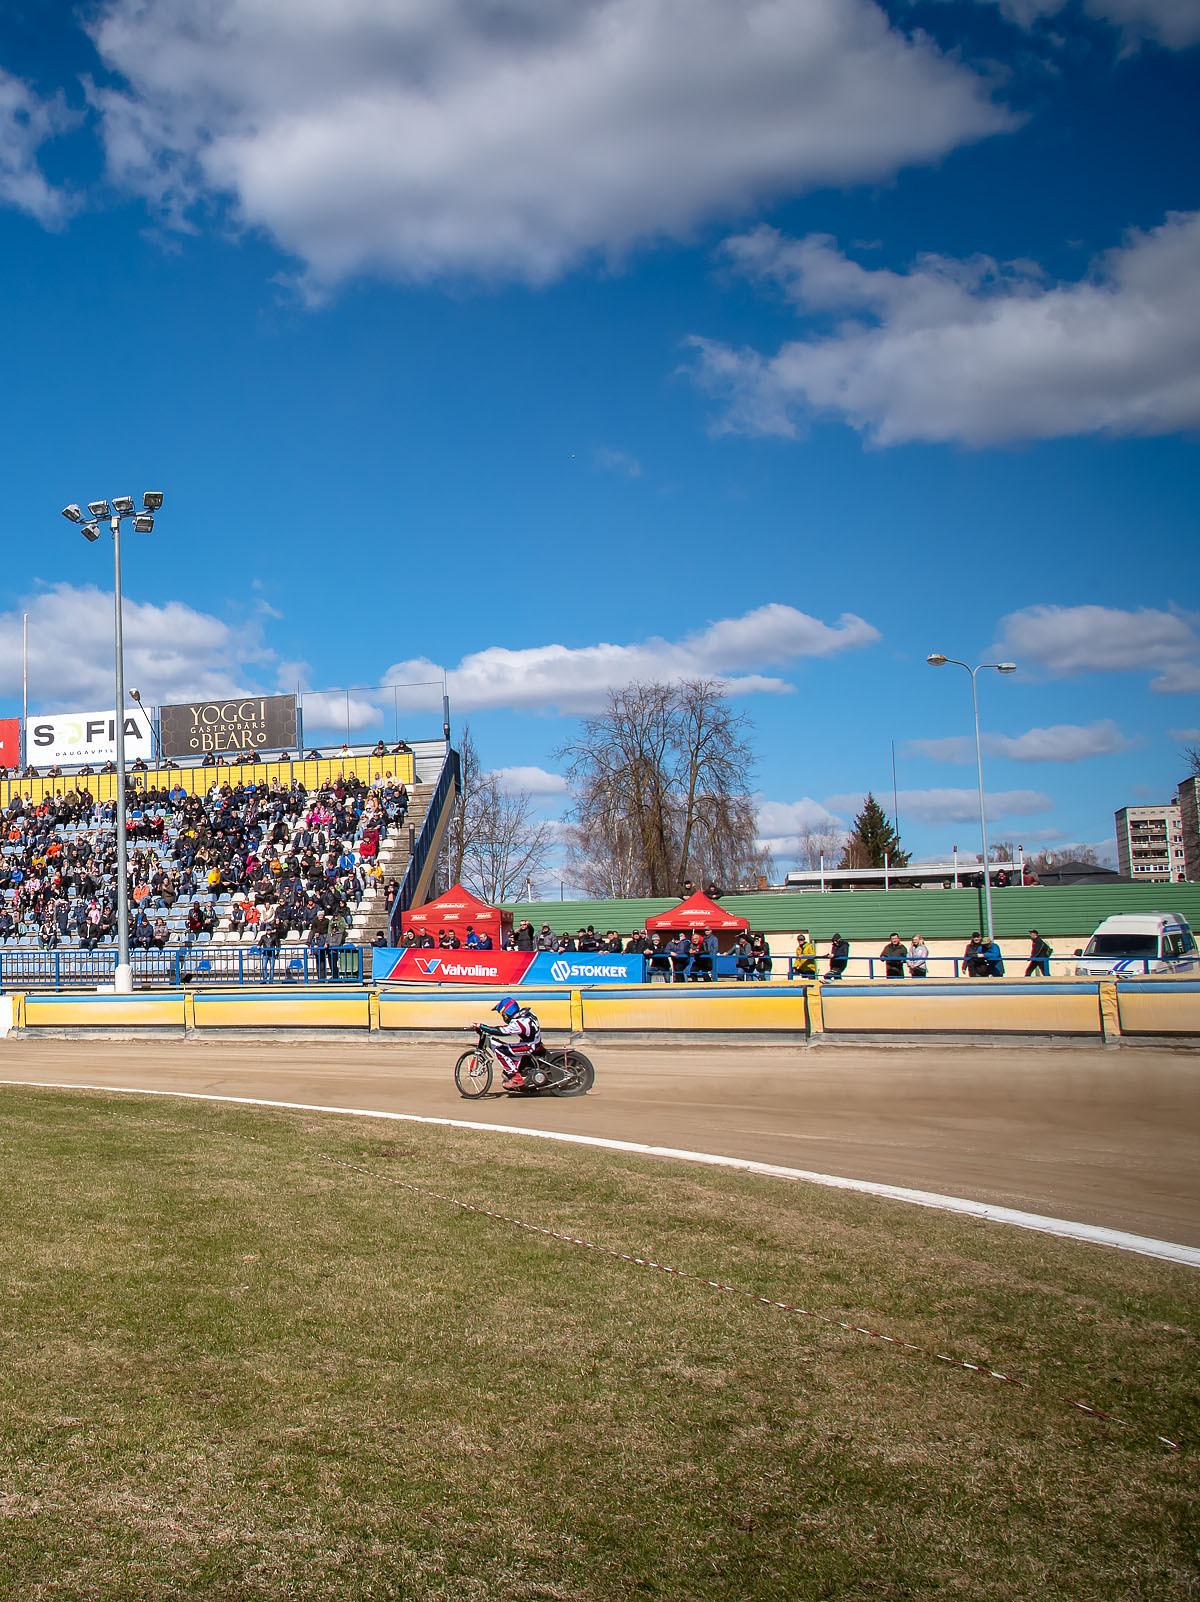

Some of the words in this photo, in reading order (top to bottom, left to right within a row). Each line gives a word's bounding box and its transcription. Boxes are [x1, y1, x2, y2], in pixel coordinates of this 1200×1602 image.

[190, 701, 265, 726] YOGGI
[190, 721, 266, 734] GASTROBĀRS
[201, 730, 259, 751] BEAR
[55, 748, 114, 757] DAUGAVPIL
[440, 963, 499, 977] Valvoline
[570, 965, 628, 978] STOKKER
